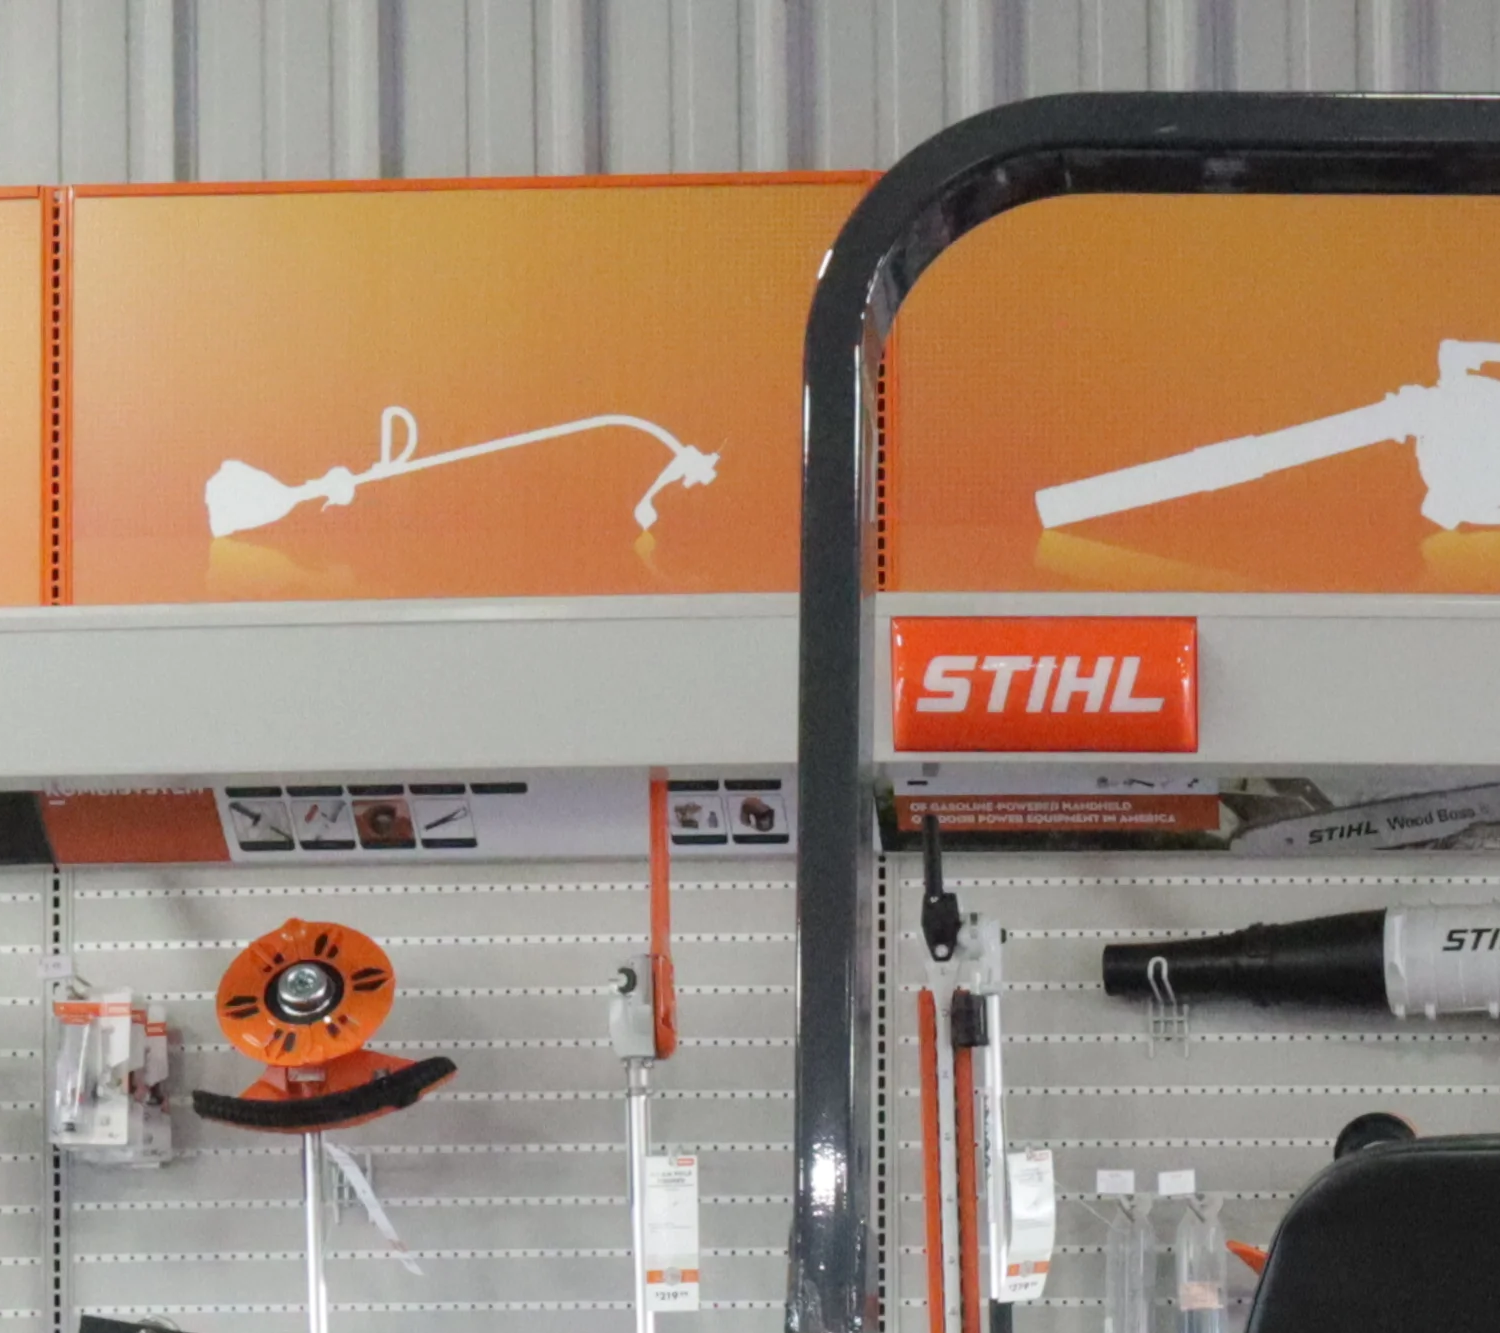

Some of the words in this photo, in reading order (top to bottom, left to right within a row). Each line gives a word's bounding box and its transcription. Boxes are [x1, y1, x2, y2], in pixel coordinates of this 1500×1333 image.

[916, 655, 1165, 713] STIHL
[911, 814, 975, 824] ODOOR
[1119, 814, 1176, 824] AMERICA
[1308, 821, 1379, 845] STIHL
[1386, 811, 1434, 831] Wood
[1437, 806, 1476, 823] Boss
